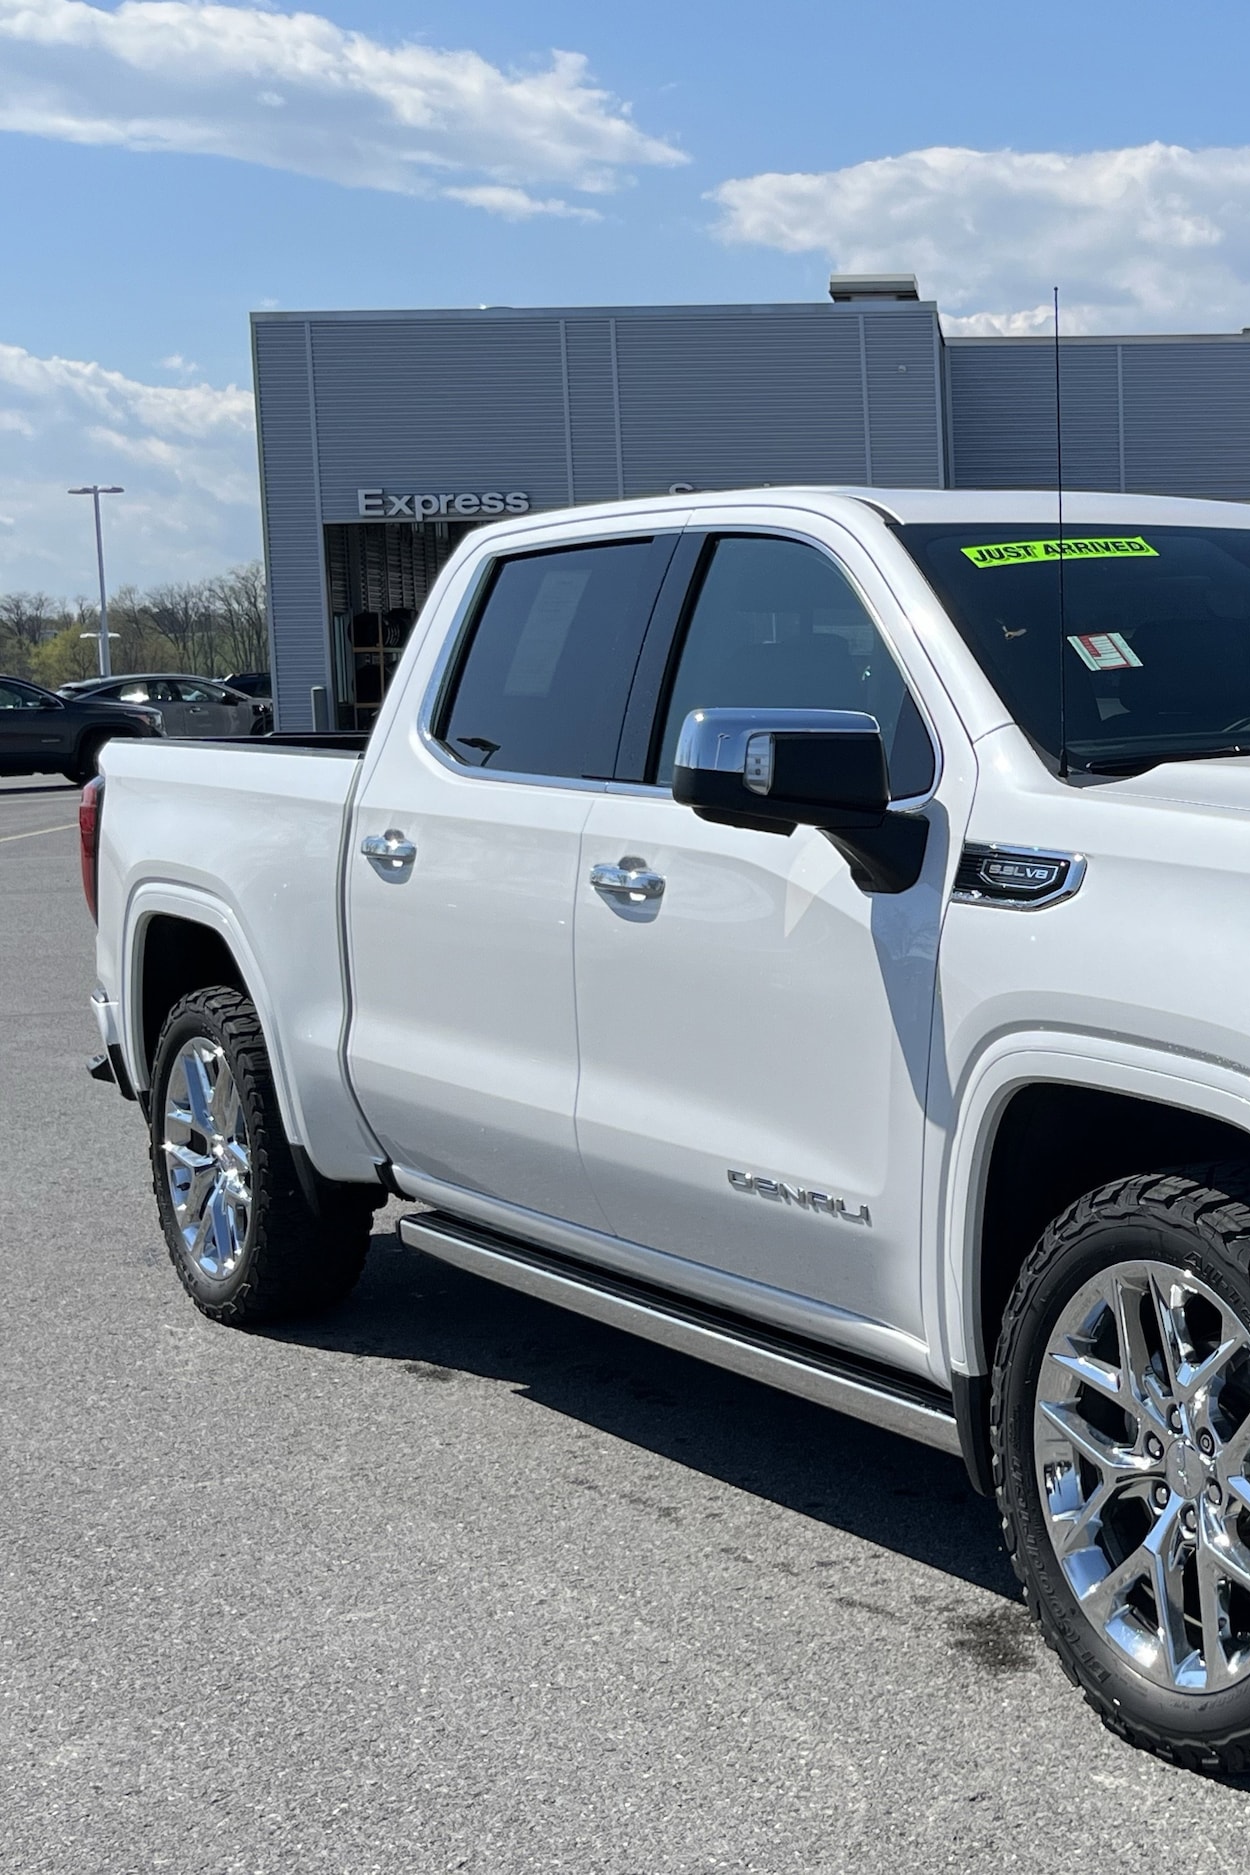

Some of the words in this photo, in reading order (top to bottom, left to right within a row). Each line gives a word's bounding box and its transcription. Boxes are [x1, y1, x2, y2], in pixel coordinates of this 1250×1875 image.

[357, 488, 529, 522] Express
[974, 545, 1036, 563] JUST
[1044, 540, 1146, 556] ARRIVED
[727, 1169, 869, 1222] DENALI
